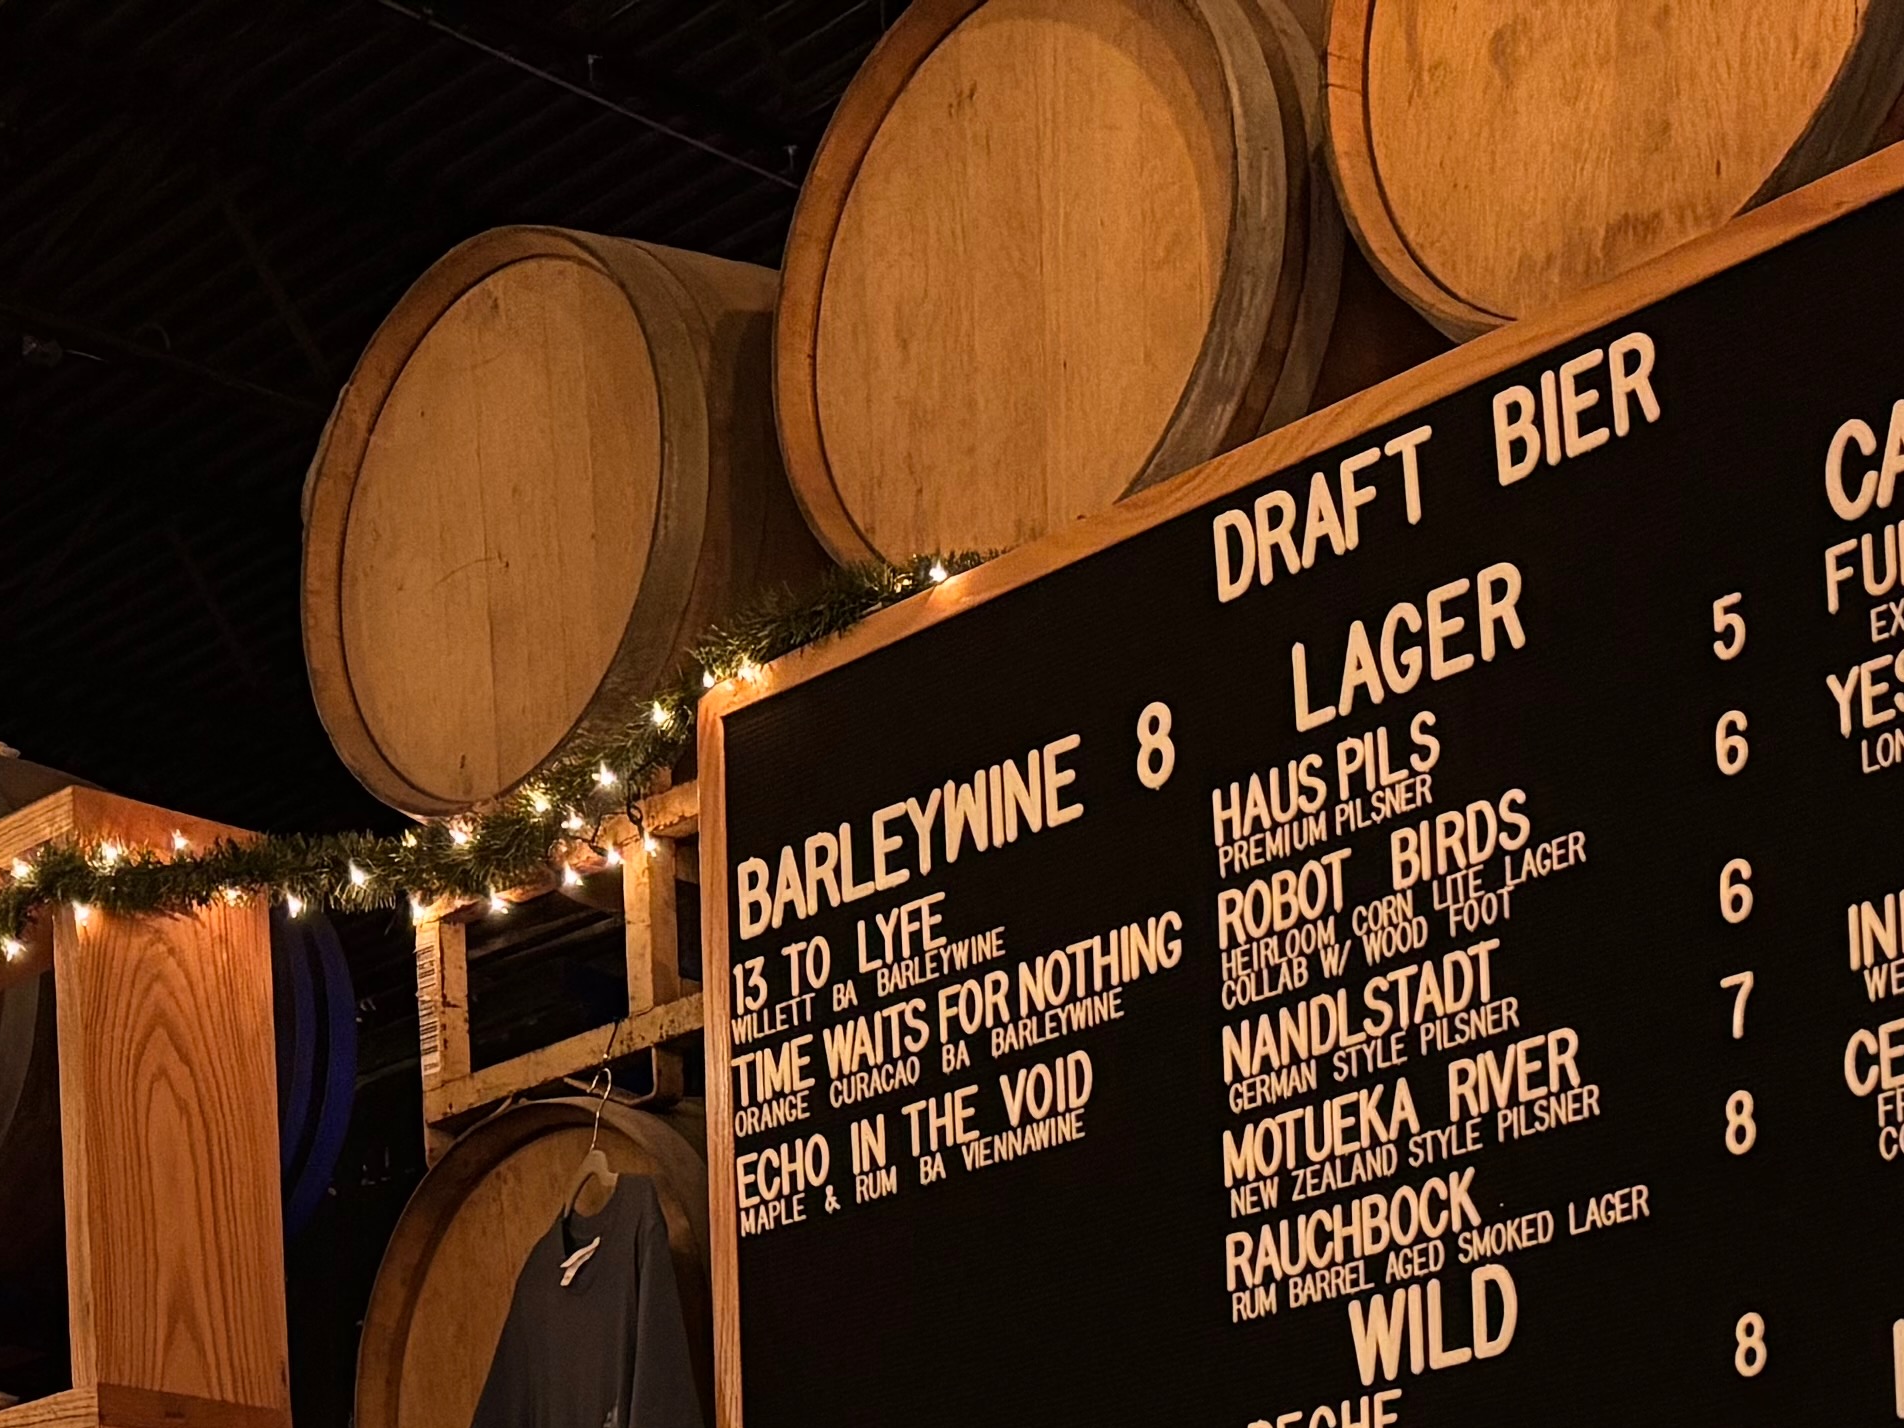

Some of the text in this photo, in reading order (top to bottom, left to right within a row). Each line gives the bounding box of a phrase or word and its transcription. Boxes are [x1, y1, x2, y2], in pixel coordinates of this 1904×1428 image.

[1213, 332, 1660, 603] DRAFT BIER
[1292, 562, 1525, 732] LAGER
[1713, 592, 1746, 660] 5
[1212, 710, 1440, 845] HAUS PILS
[1715, 709, 1748, 775] 6
[738, 701, 1175, 939] BARLEYWINE 8
[1218, 788, 1530, 949] ROBOT BIRDS
[1219, 773, 1433, 878] PREMIUM PILSNER
[734, 892, 946, 1015] 13 TO LYFE
[1221, 831, 1586, 982] HEIRLOOM CORN LITE LAGER
[1221, 887, 1514, 1010] COLLAB W/ WOOD FOOT
[1719, 858, 1752, 923] 6
[731, 911, 1182, 1107] TIME WAITS FOR NOTHING
[732, 927, 1005, 1045] WILLETT BA BARLEYWINE
[1222, 938, 1754, 1085] NANDLSTADT 7
[735, 987, 1124, 1138] ORANGE CURACAO BA BARLEYWINE
[1223, 1027, 1756, 1188] MOTUEKA RIVER 8
[1228, 997, 1520, 1115] GERMAN STYLE PILSNER
[736, 1050, 1092, 1208] ECHO IN THE VOID
[740, 1109, 1085, 1237] MAPLE & RUM BA VIENNAWINE
[1230, 1084, 1601, 1218] NEW ZEALAND STYLE PILSNER
[1225, 1166, 1482, 1291] RAUCHBOCK
[1232, 1185, 1650, 1323] RUM BARREL AGED SMOKED LAGER
[1348, 1264, 1518, 1387] WILD
[1734, 1311, 1767, 1377] 8
